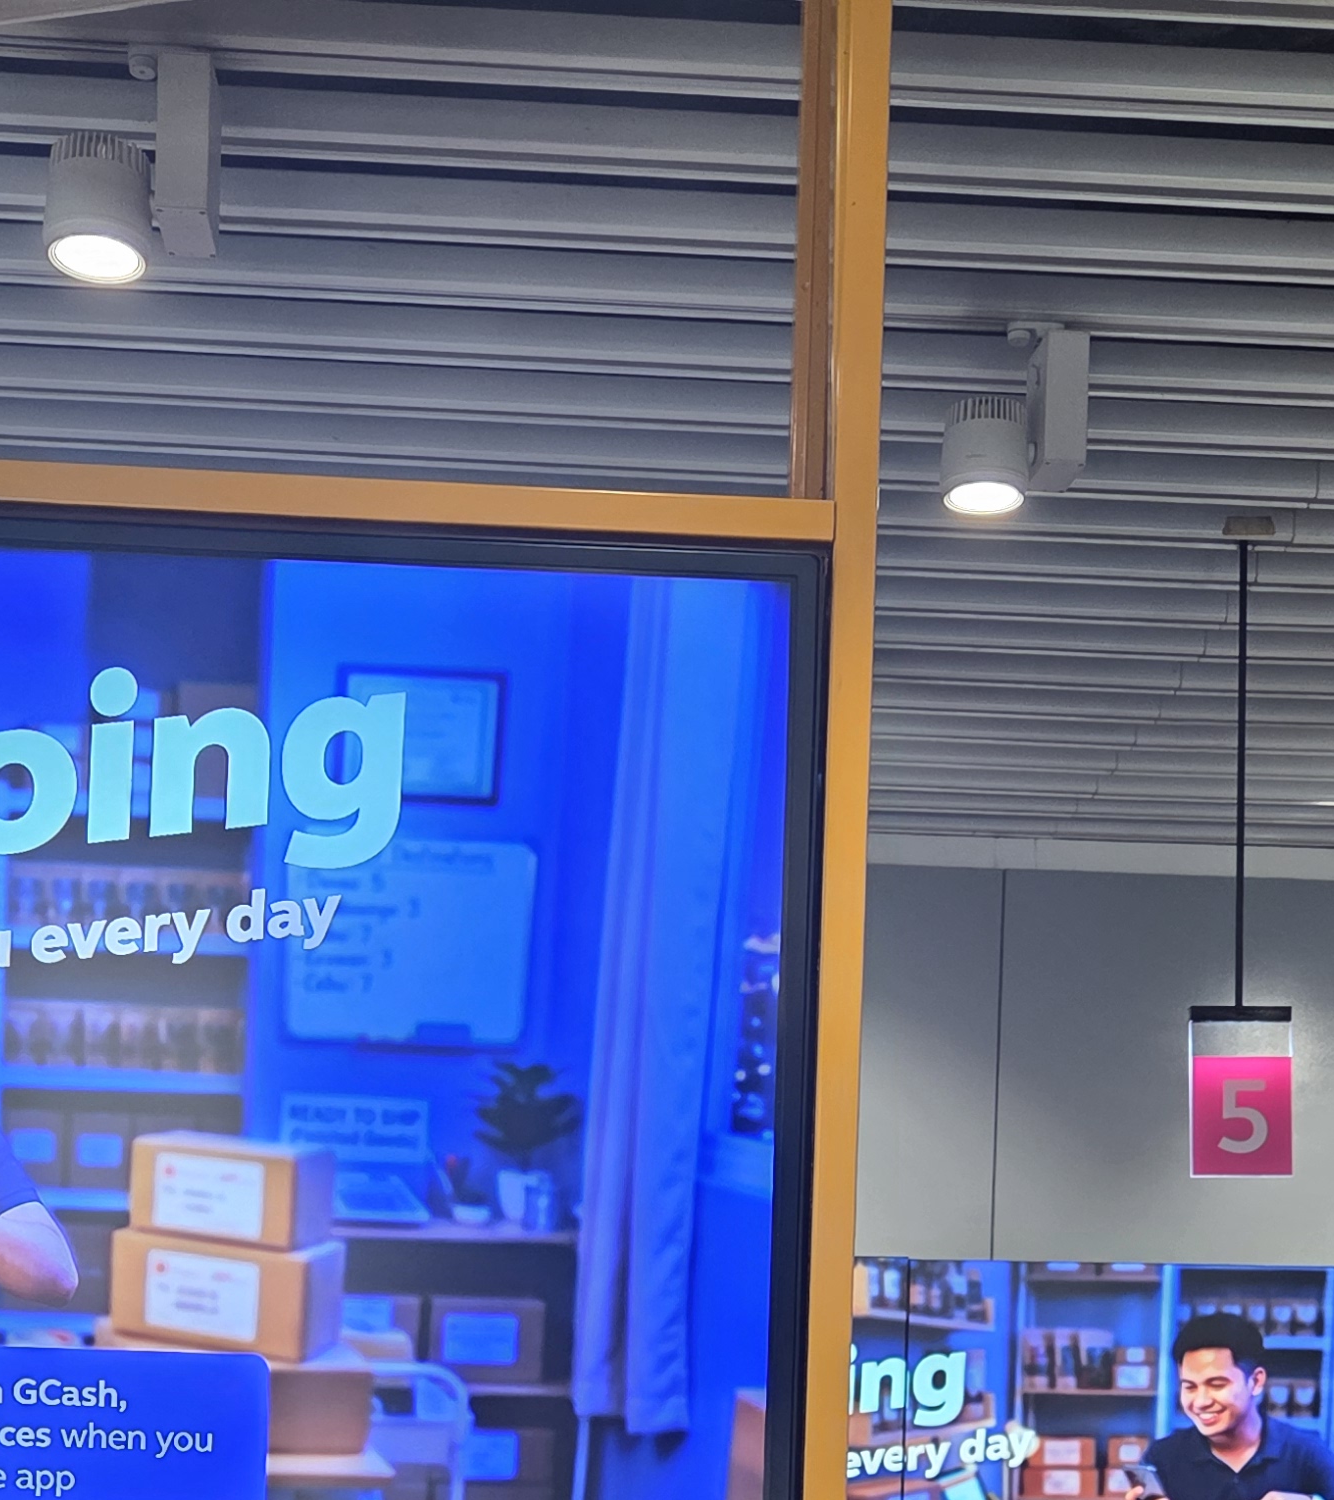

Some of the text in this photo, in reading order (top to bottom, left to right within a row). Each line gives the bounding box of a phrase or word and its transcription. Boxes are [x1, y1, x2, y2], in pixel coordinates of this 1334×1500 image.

[31, 908, 210, 965] every
[226, 888, 342, 950] day
[1217, 1078, 1269, 1155] 5
[13, 1378, 127, 1412] GCash,
[60, 1423, 147, 1450] when
[155, 1430, 213, 1459] you
[846, 1428, 1036, 1479] every day
[15, 1467, 76, 1497] app
